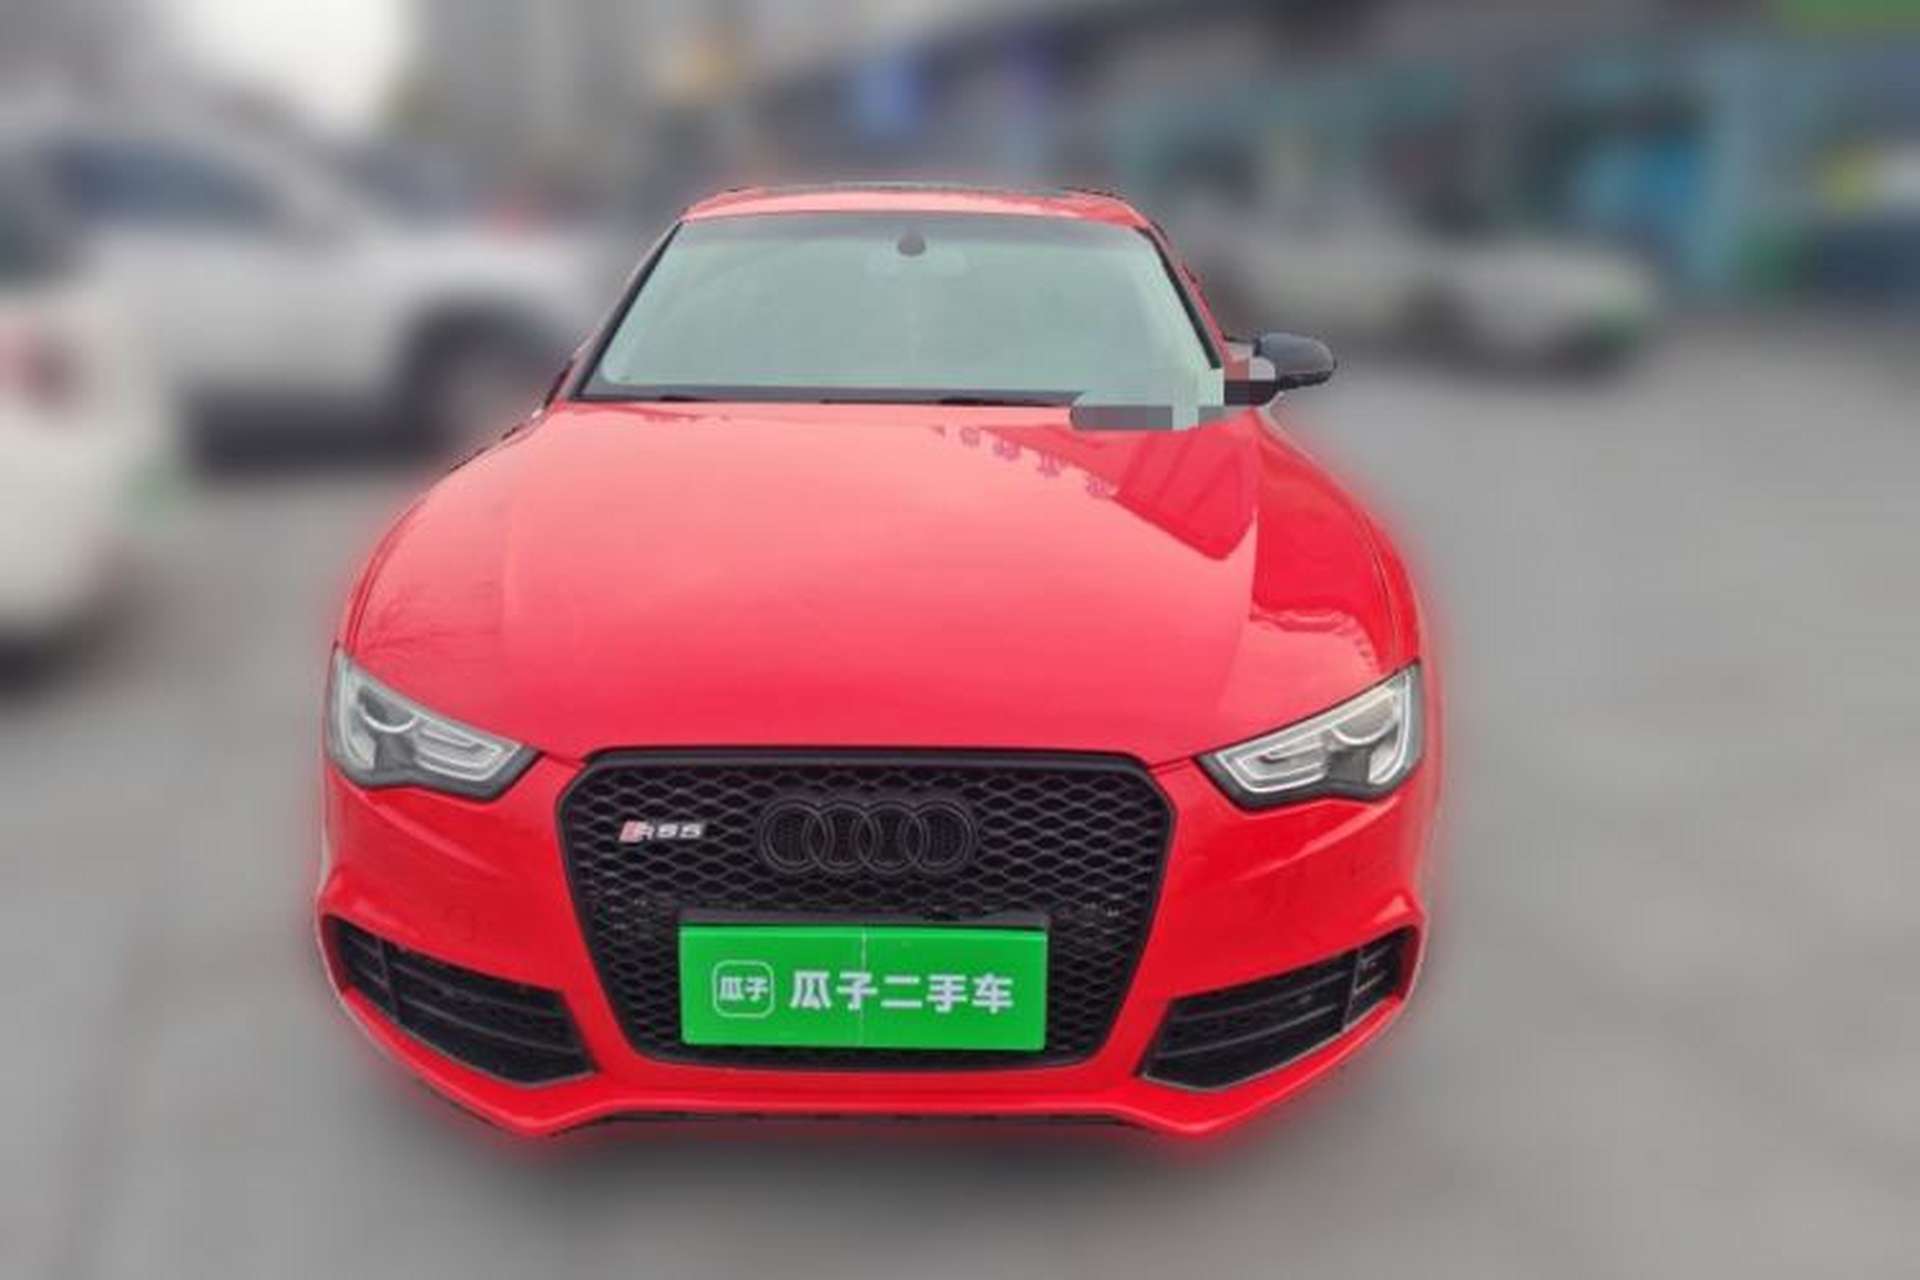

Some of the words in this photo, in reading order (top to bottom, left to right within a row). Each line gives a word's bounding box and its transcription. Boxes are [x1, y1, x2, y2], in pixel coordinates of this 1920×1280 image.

[719, 976, 769, 1001] 瓜子
[789, 970, 1014, 1014] 瓜子二手车
